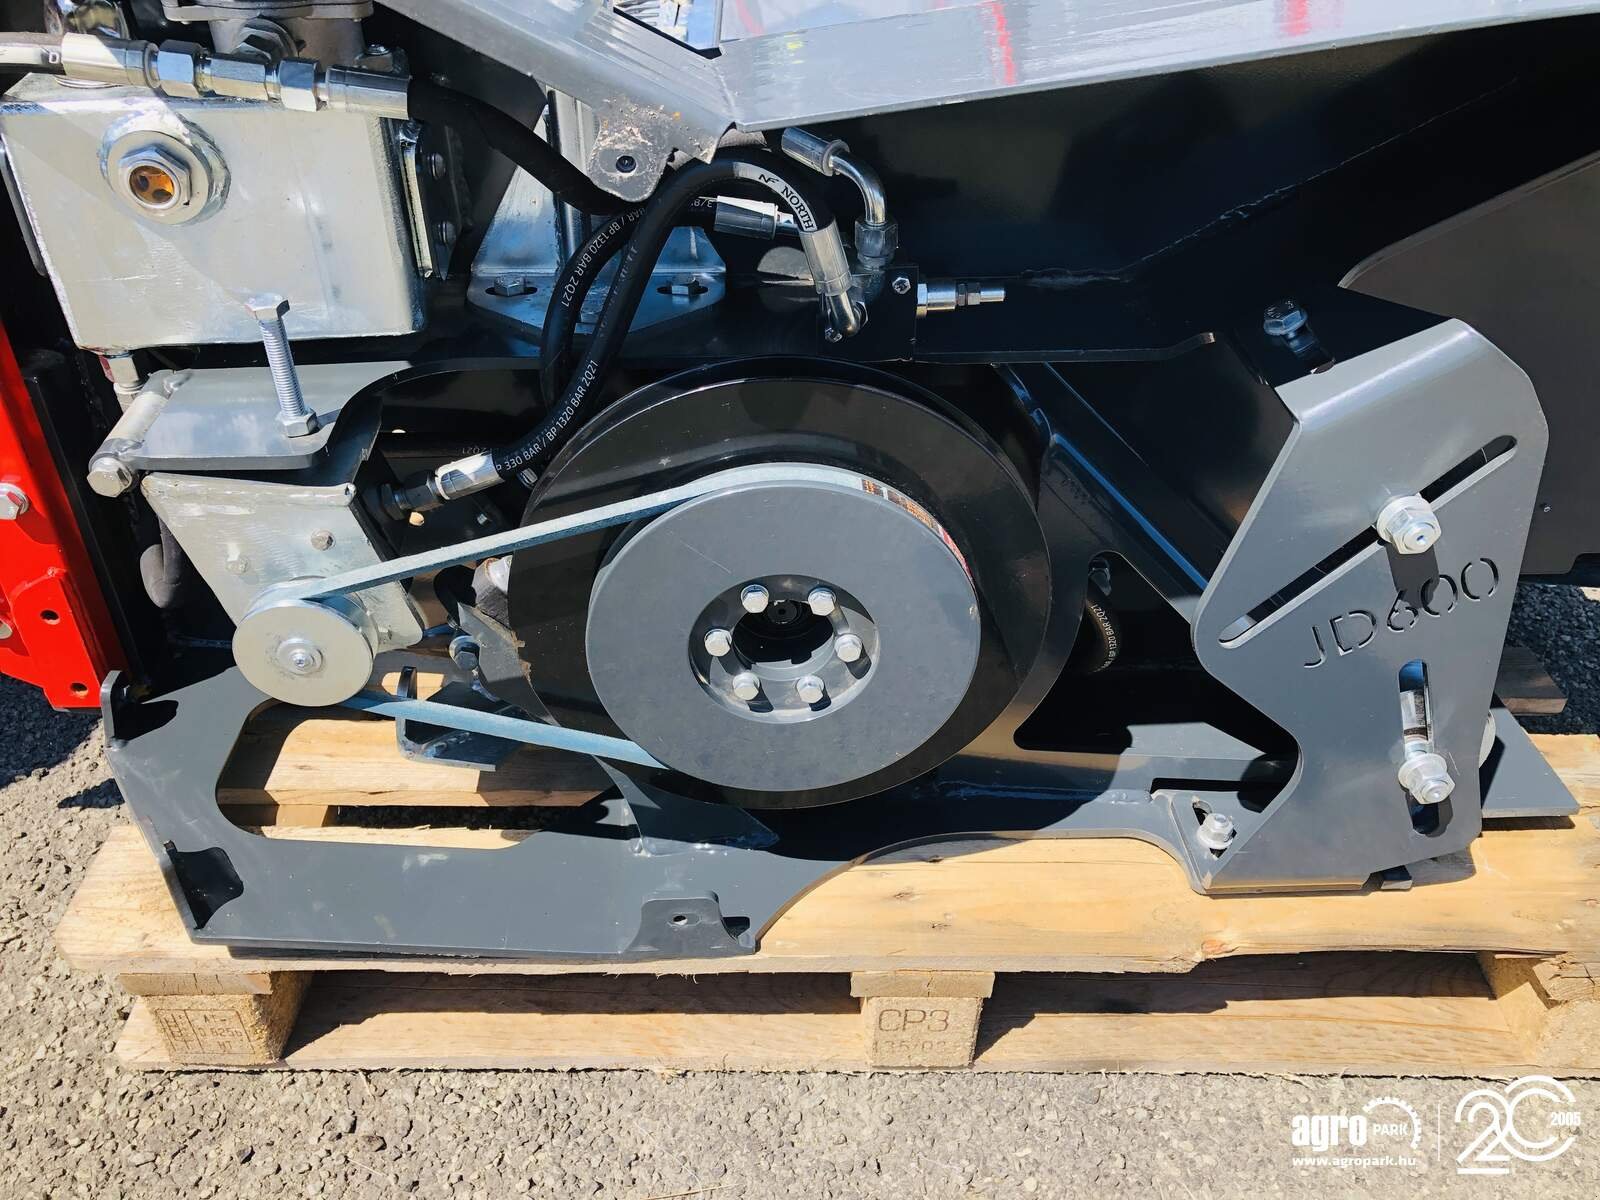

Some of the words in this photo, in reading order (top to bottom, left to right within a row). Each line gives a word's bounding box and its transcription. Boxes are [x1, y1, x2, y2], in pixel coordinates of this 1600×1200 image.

[781, 186, 814, 229] NORTH
[590, 231, 610, 255] 1320
[609, 222, 621, 236] BP
[574, 253, 592, 276] BAR
[561, 275, 579, 308] 2Q21
[504, 456, 523, 471] 330
[522, 443, 542, 461] BAR
[545, 427, 558, 442] BP
[555, 406, 575, 431] 1320
[570, 385, 587, 408] BAR
[581, 360, 599, 387] 2Q21
[1303, 557, 1499, 669] JD600
[879, 1008, 950, 1032] CP3
